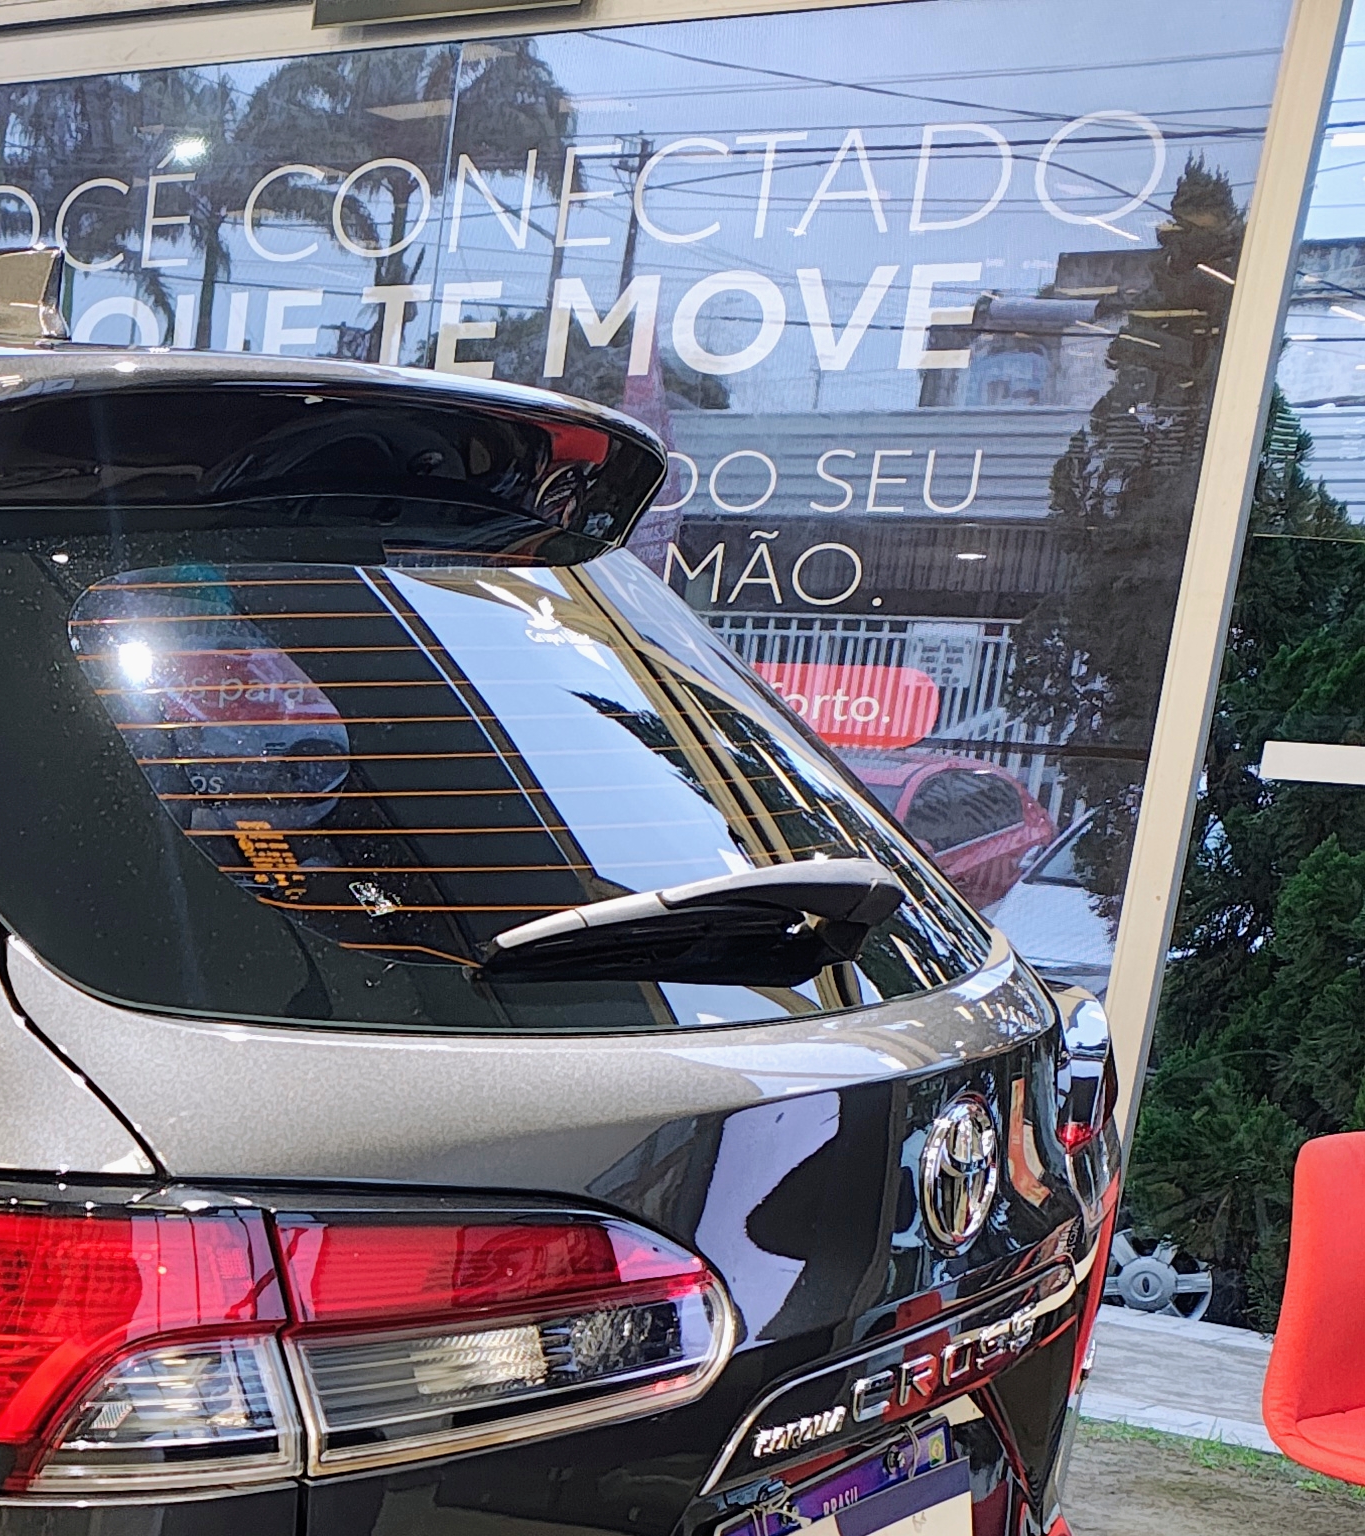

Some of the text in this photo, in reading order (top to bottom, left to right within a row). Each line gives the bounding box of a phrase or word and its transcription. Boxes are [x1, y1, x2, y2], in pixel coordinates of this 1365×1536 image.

[244, 109, 1167, 263] CONECTADO
[361, 280, 503, 379] TE
[543, 262, 983, 378] MOVE
[809, 448, 983, 514] SEU
[663, 530, 884, 607] MÃO.
[851, 1301, 1037, 1423] CROSS
